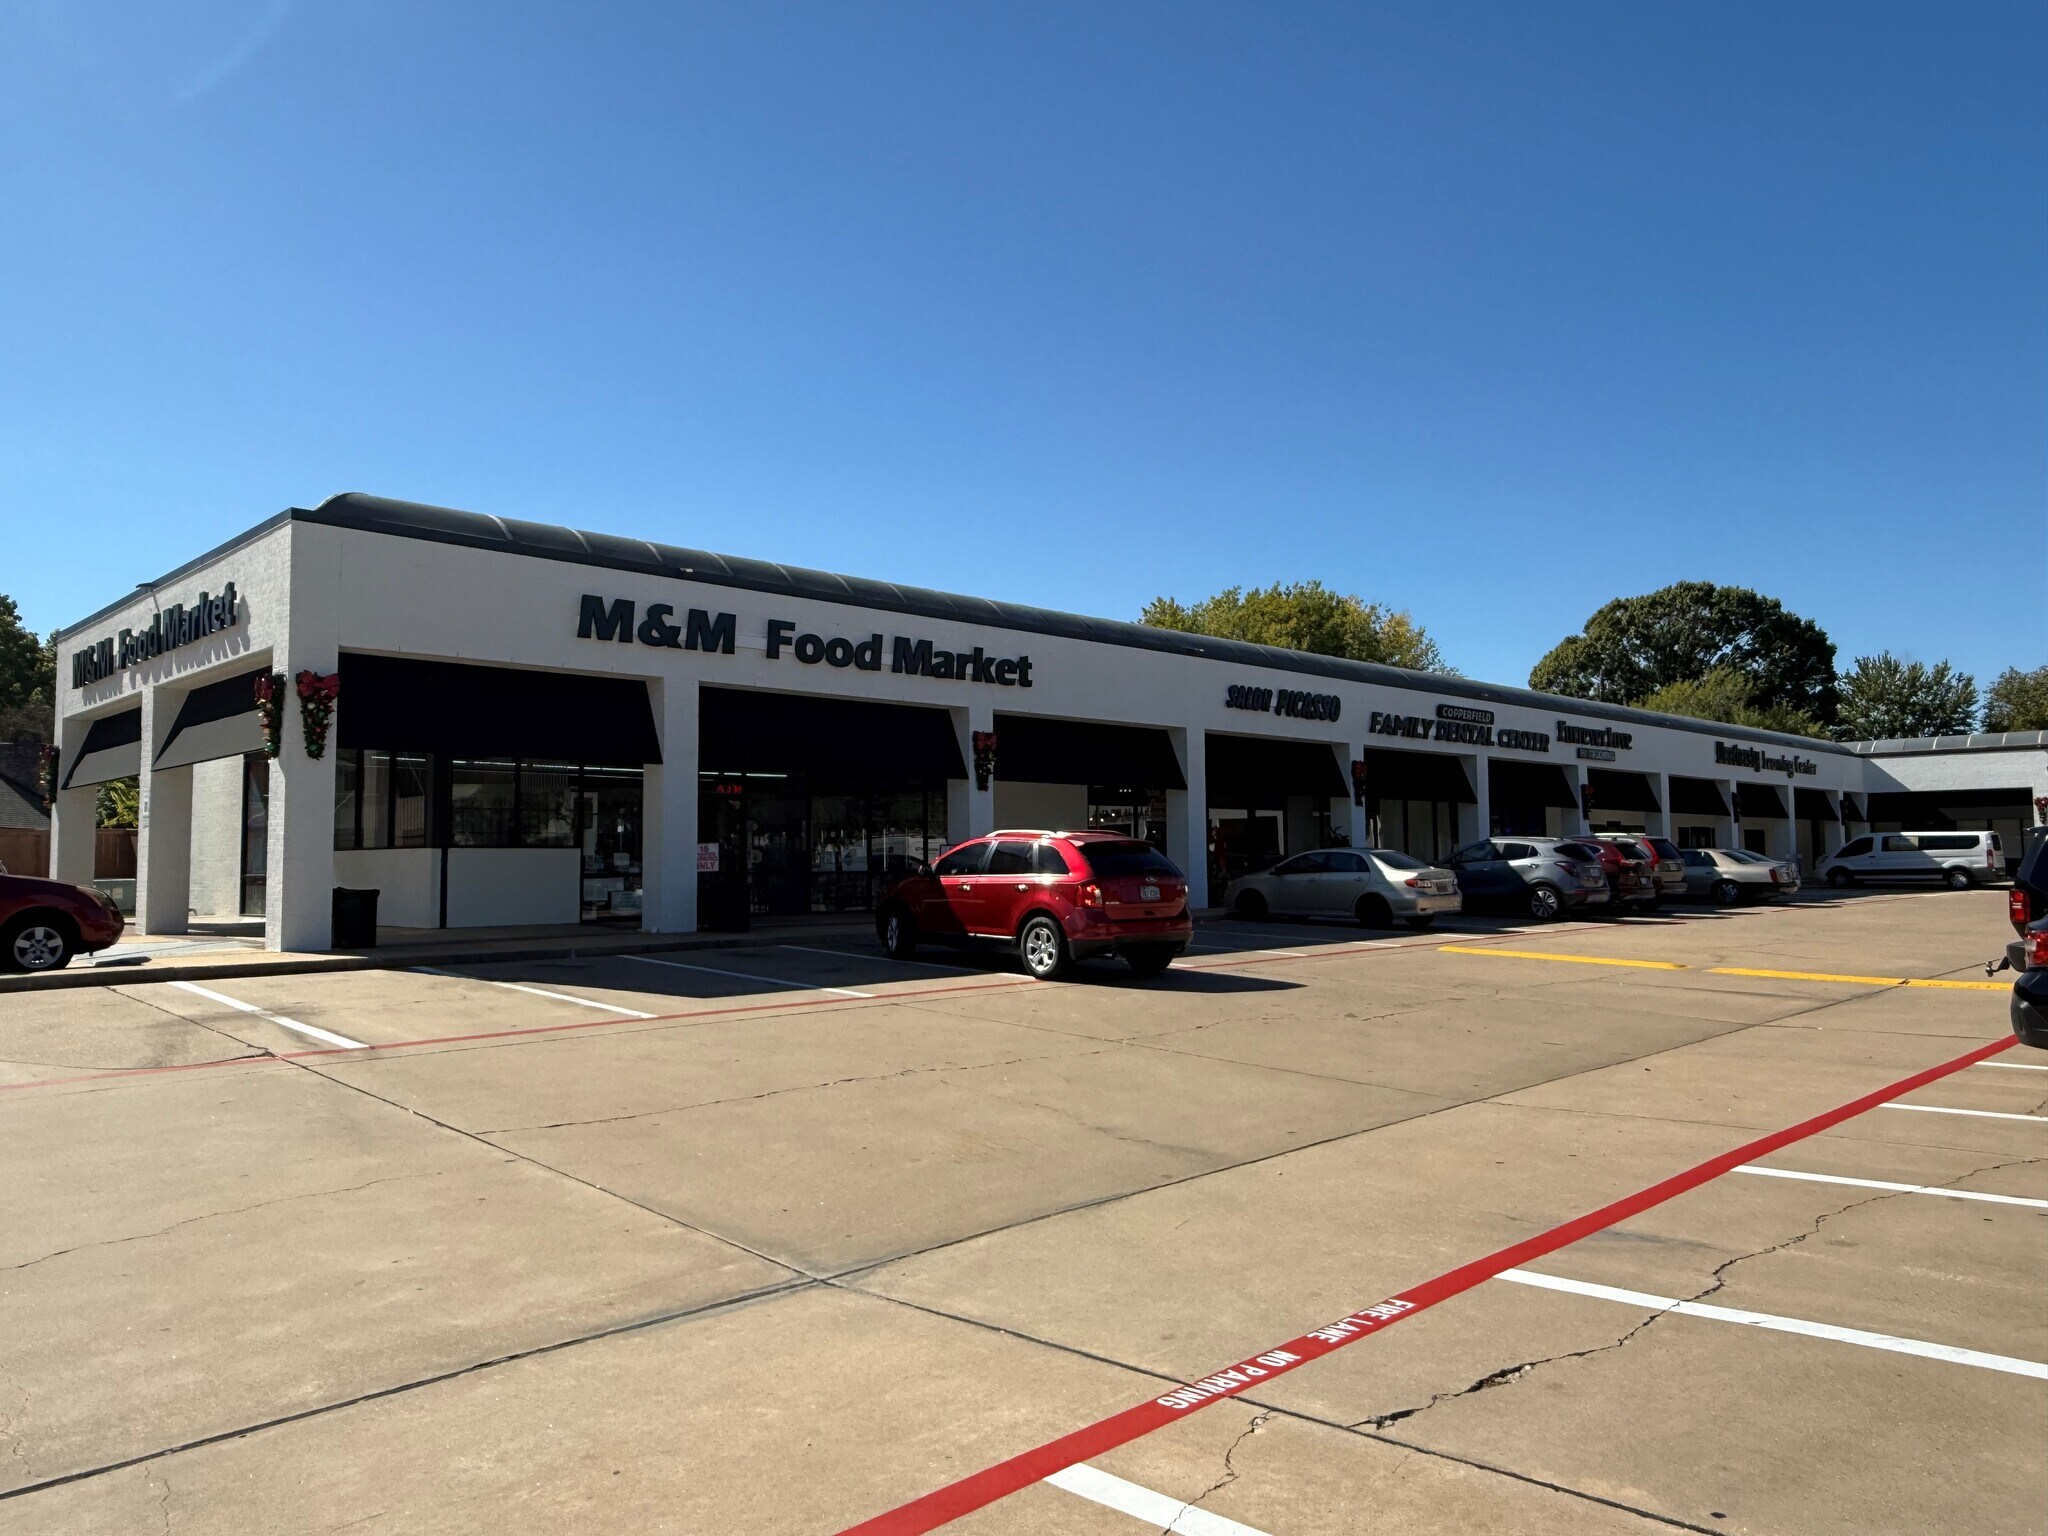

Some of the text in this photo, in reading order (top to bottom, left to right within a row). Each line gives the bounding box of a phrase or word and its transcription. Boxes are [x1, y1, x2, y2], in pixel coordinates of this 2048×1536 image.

[72, 581, 237, 689] M&M Food Market
[577, 594, 1033, 687] M&M Food Market
[1226, 684, 1341, 722] SALON PICASSO
[1369, 711, 1550, 752] FAMILY DENTAL CENTER
[1442, 707, 1491, 722] COPPERFIELD
[1157, 1299, 1417, 1409] FIRE LANE NO PARKING
